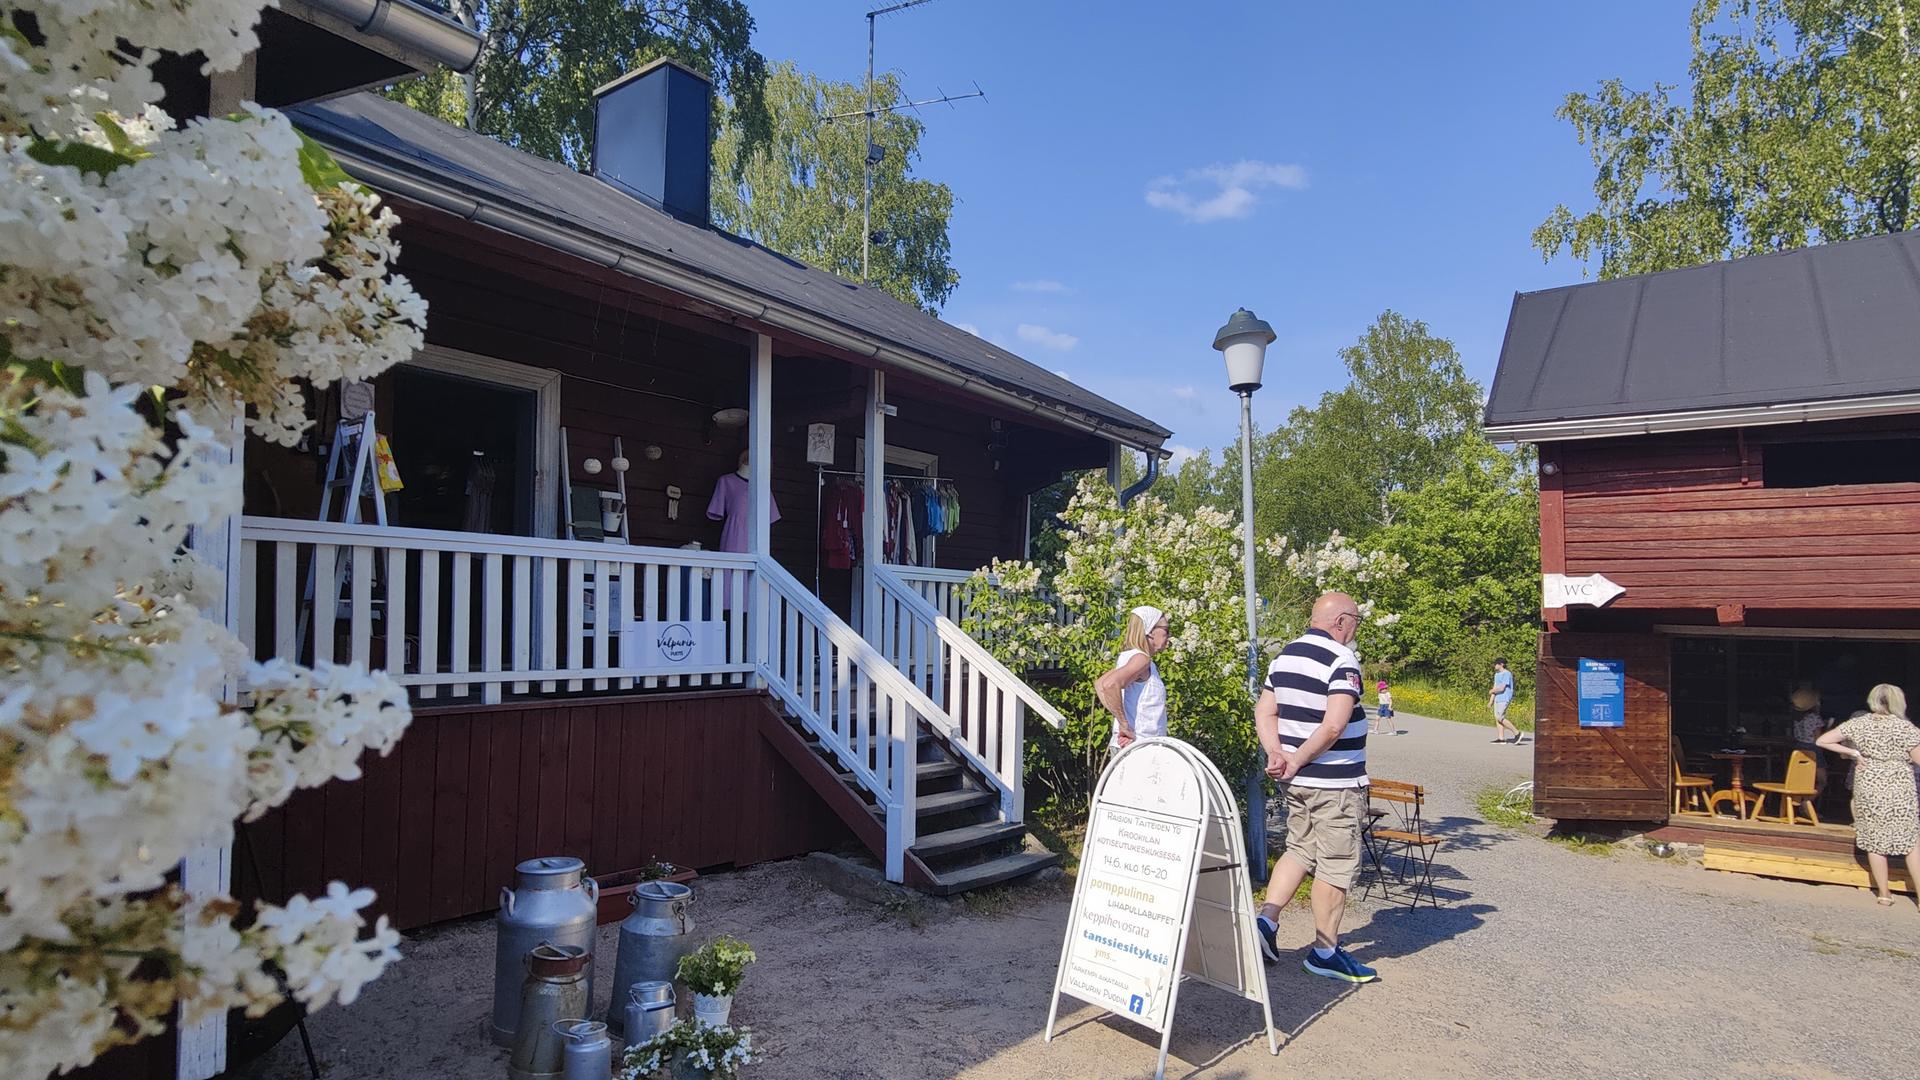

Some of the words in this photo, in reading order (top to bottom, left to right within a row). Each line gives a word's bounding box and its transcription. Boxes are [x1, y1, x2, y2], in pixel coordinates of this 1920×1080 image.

[1564, 583, 1593, 596] WC
[657, 637, 696, 650] Valpurin
[1135, 817, 1171, 833] TAITEIDEN
[1118, 828, 1161, 846] KROOKILAN
[1123, 862, 1139, 873] KLO
[1141, 864, 1168, 881] 16-20
[1090, 878, 1155, 903] pomppulinna
[1083, 906, 1150, 938] keppihevosrata
[1107, 899, 1176, 926] LIHAPULLABUFFET
[1083, 929, 1169, 966] tanssiesityksiä
[1069, 976, 1102, 995] VALPURIN
